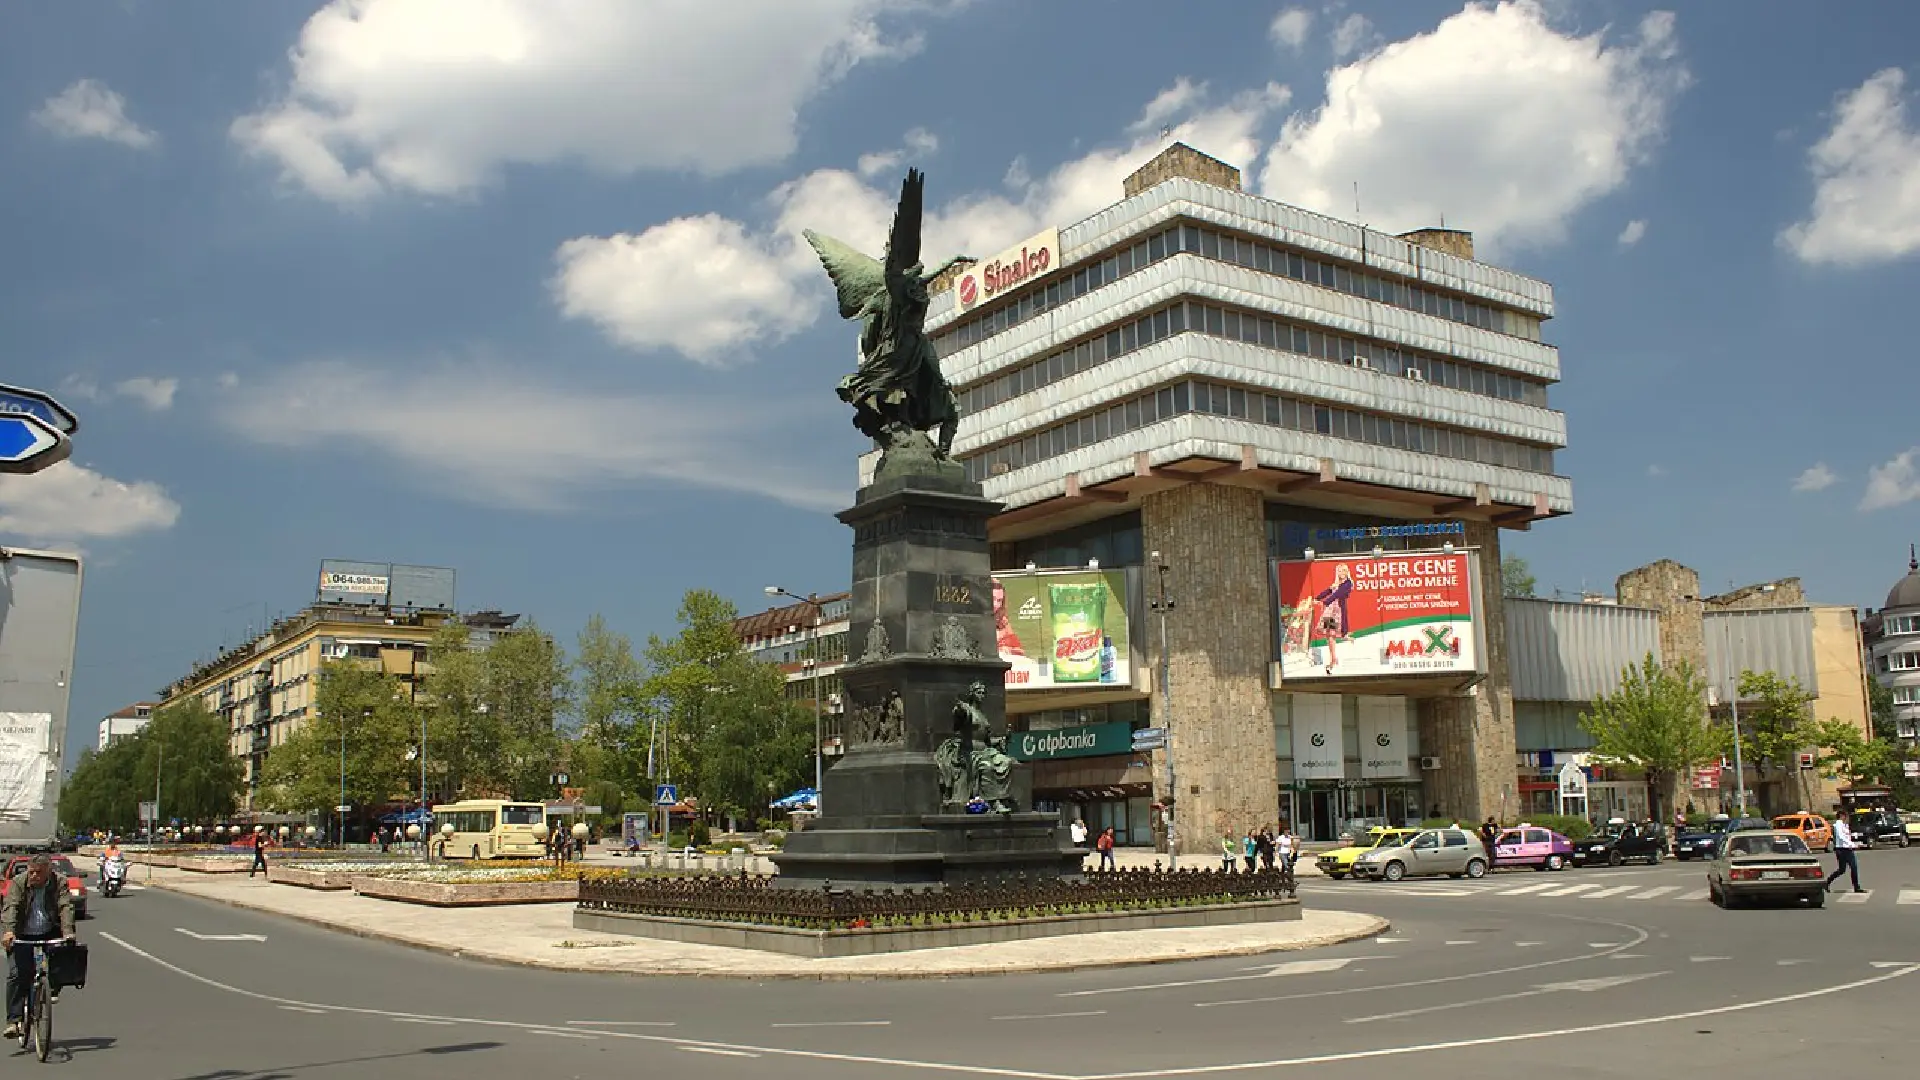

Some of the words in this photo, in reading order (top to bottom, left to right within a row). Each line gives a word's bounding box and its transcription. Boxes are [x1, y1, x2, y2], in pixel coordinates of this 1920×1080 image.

[983, 246, 1050, 293] Sinalco
[1355, 561, 1411, 579] SUPER
[1413, 558, 1457, 576] CENE
[1355, 578, 1396, 591] SVUDA
[1397, 577, 1423, 589] OKO
[1424, 574, 1459, 588] MENE
[1385, 625, 1461, 657] MAXI
[1037, 728, 1096, 756] otpbanka
